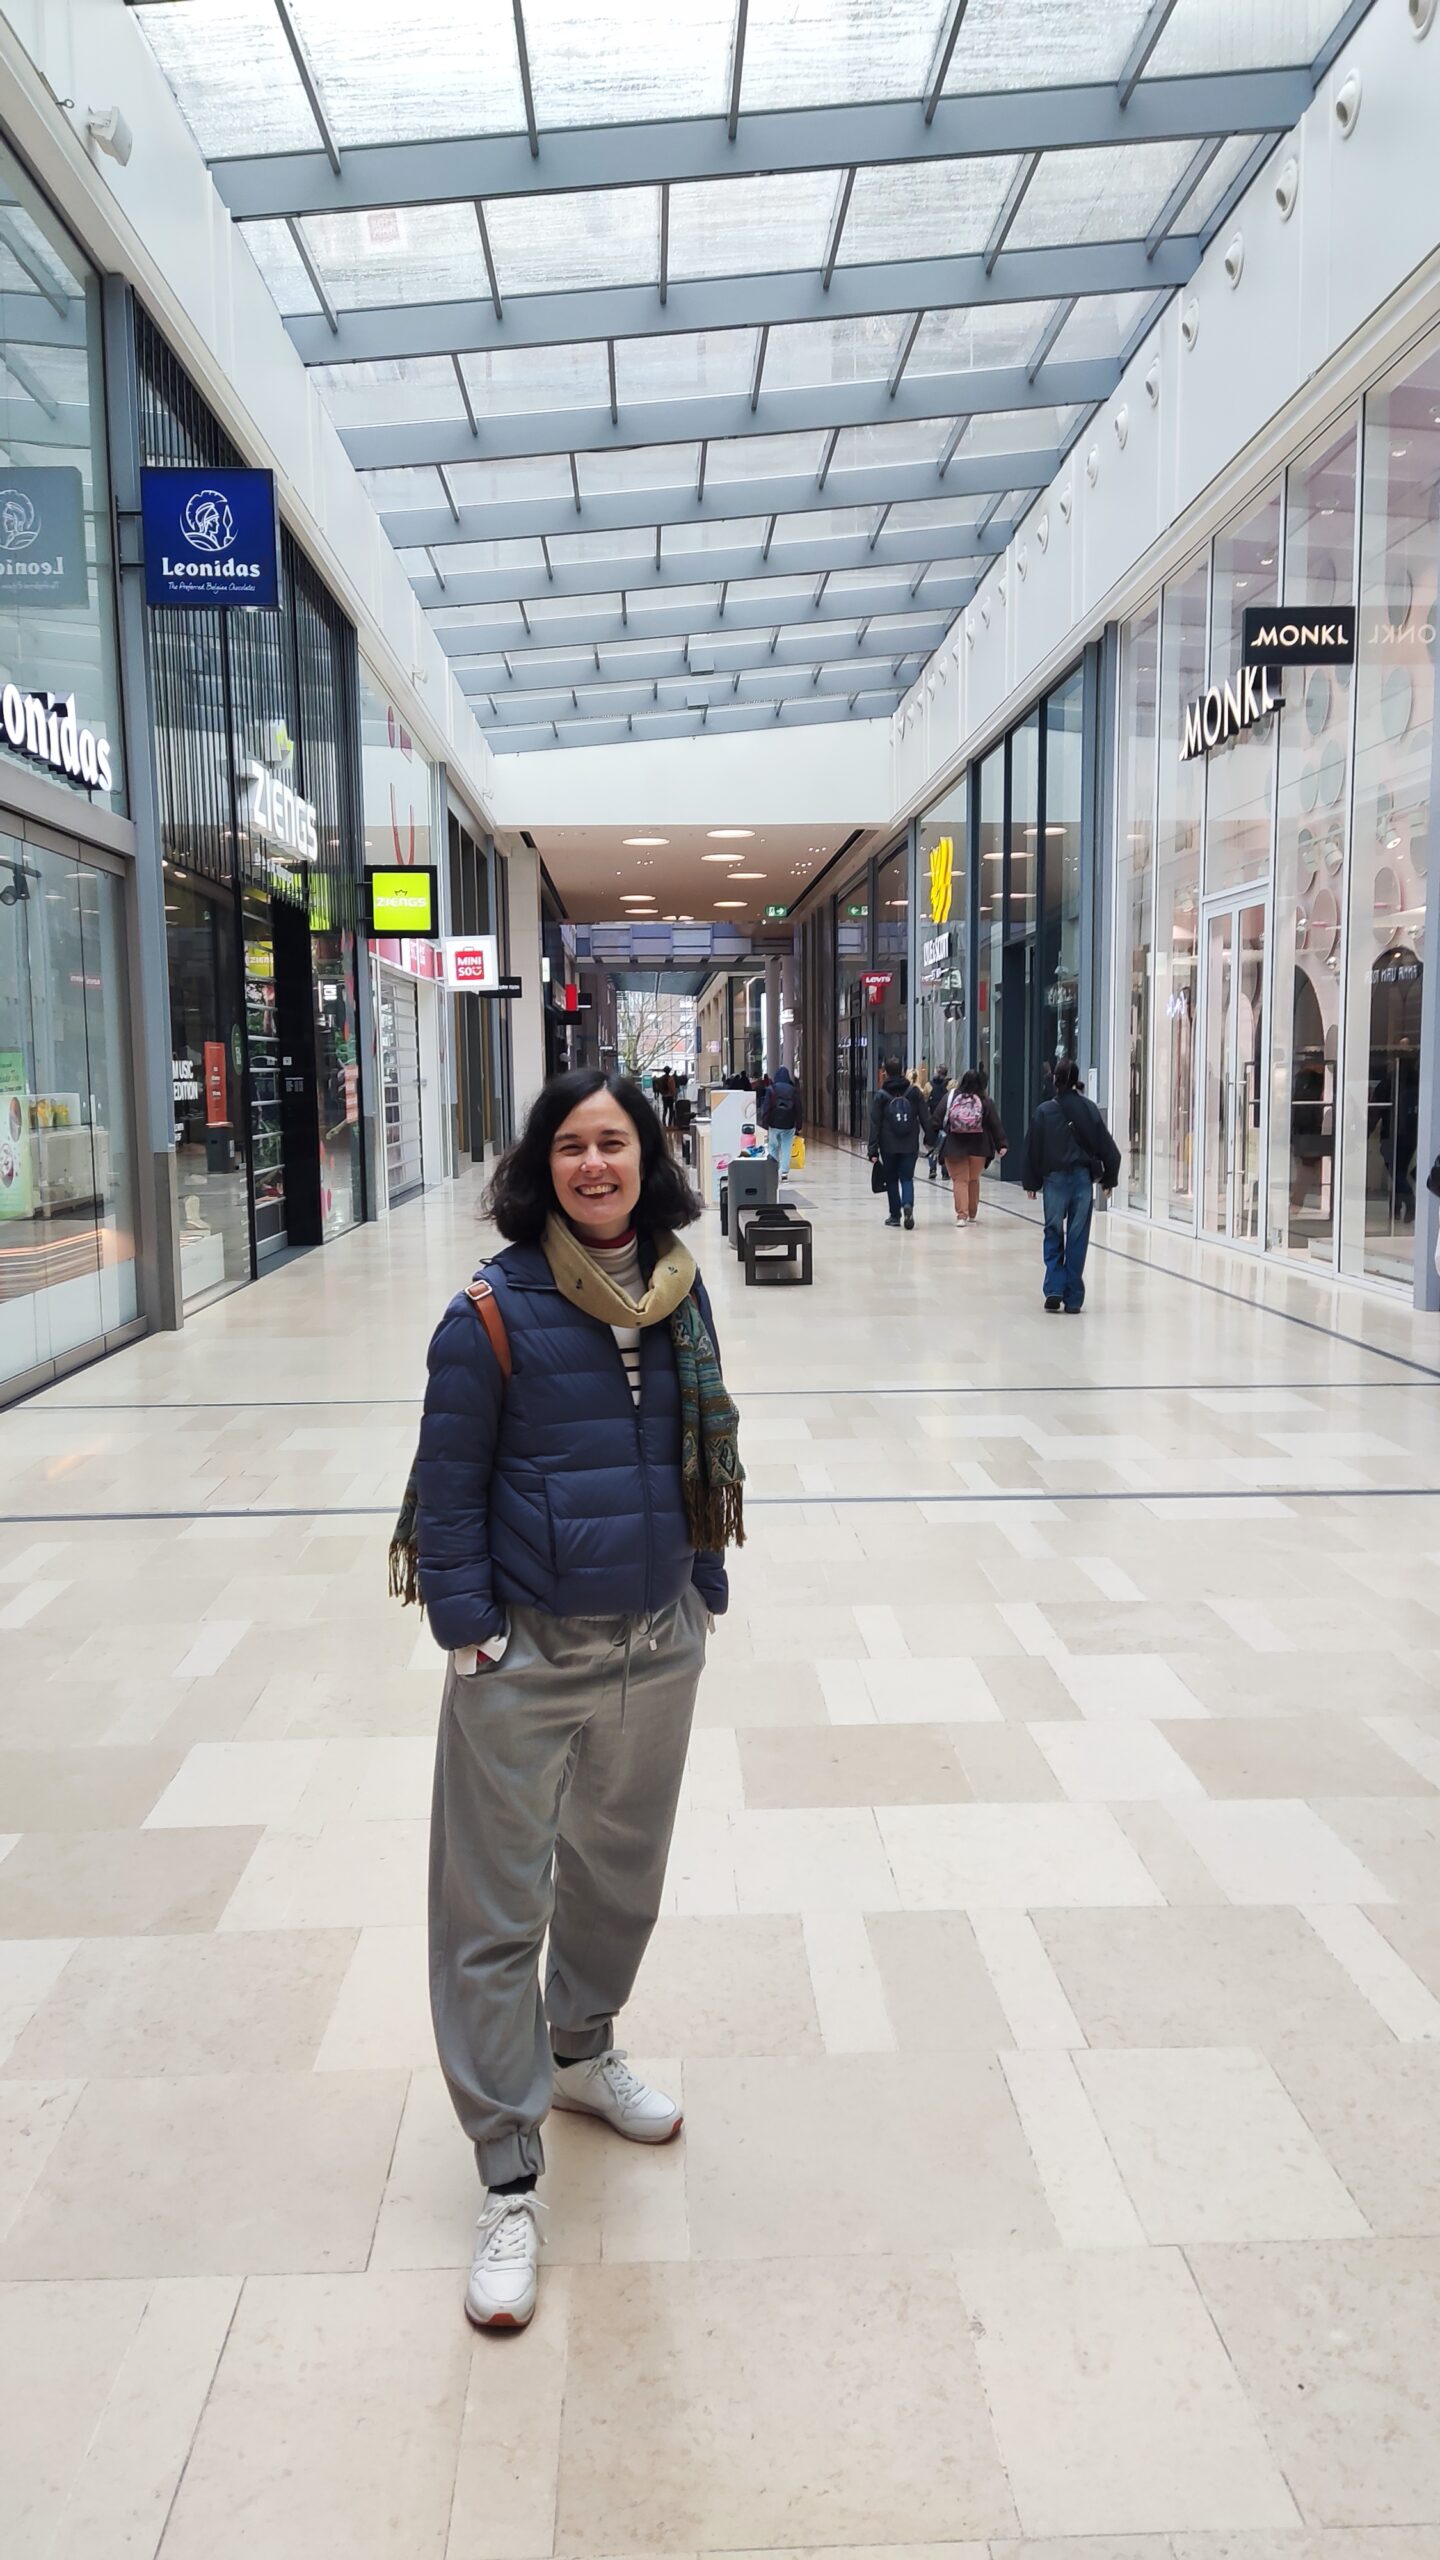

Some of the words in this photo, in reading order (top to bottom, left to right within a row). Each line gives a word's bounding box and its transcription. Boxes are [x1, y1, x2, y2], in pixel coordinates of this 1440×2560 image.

[162, 557, 260, 577] Leonidas
[168, 581, 178, 590] The
[0, 683, 112, 791] onidas
[457, 956, 482, 966] MINI
[172, 1060, 194, 1080] MUSIC
[173, 1081, 199, 1101] EDITION
